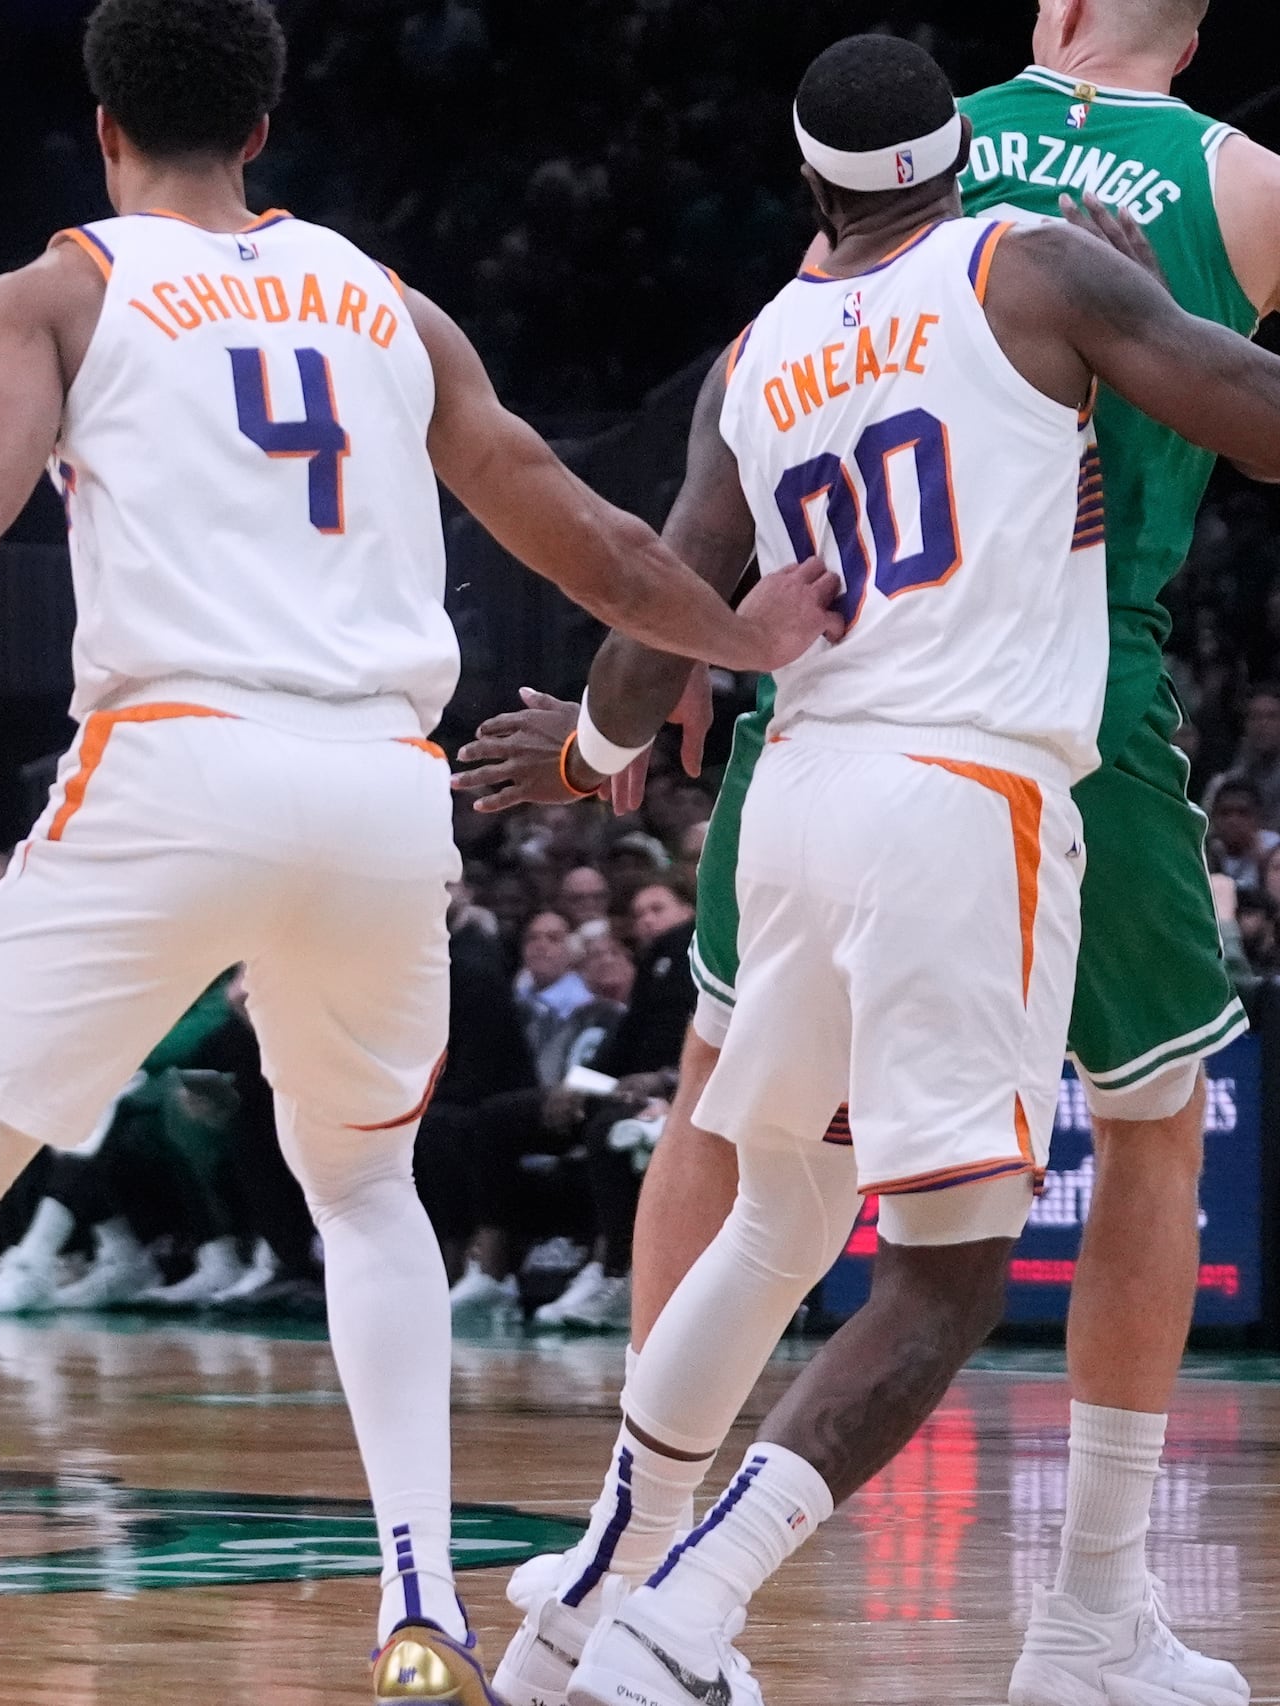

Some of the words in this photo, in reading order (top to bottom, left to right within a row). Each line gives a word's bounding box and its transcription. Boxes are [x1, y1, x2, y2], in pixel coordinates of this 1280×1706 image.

[956, 131, 1182, 225] ORZINGIS
[128, 272, 399, 349] IGHODARO
[763, 313, 939, 433] O'NEALE
[225, 347, 351, 535] 4
[774, 407, 963, 636] 00
